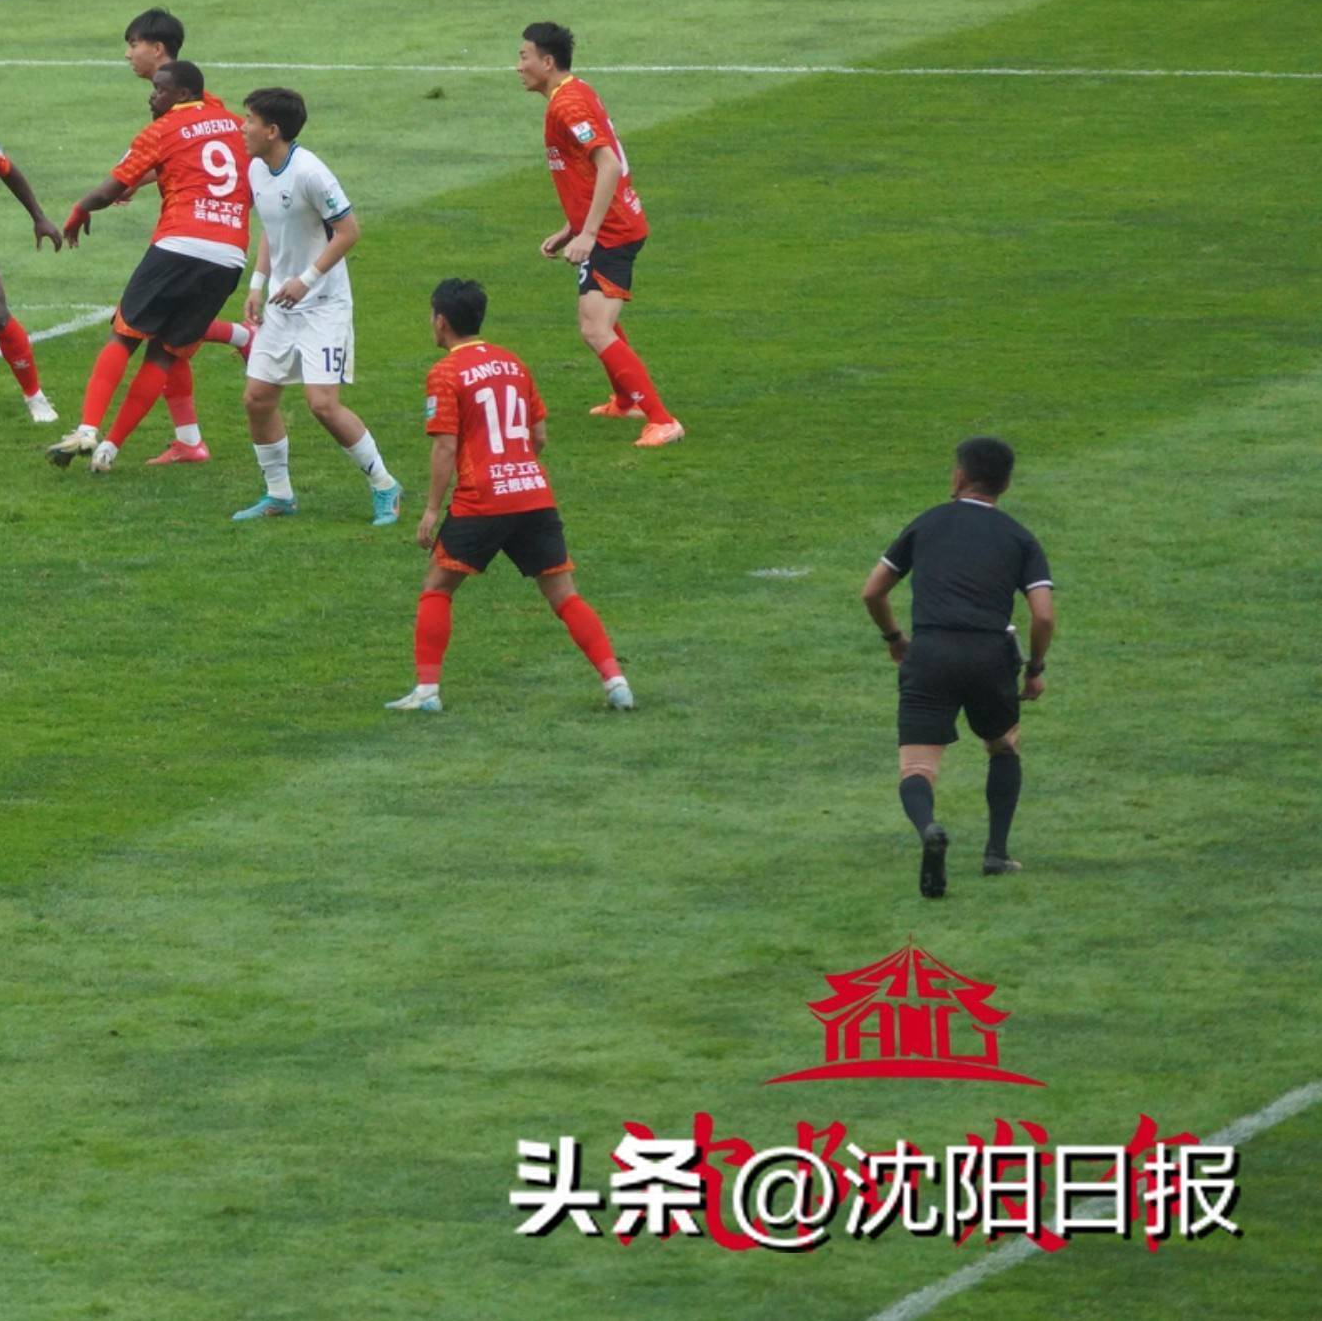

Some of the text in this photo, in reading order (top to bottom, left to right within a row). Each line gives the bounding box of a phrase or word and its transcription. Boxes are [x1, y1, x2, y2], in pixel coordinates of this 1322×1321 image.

[180, 118, 238, 140] G.MBENZA
[201, 140, 238, 197] 9
[322, 347, 343, 373] 15
[474, 384, 530, 455] 14
[488, 461, 541, 479] 辽宁工行
